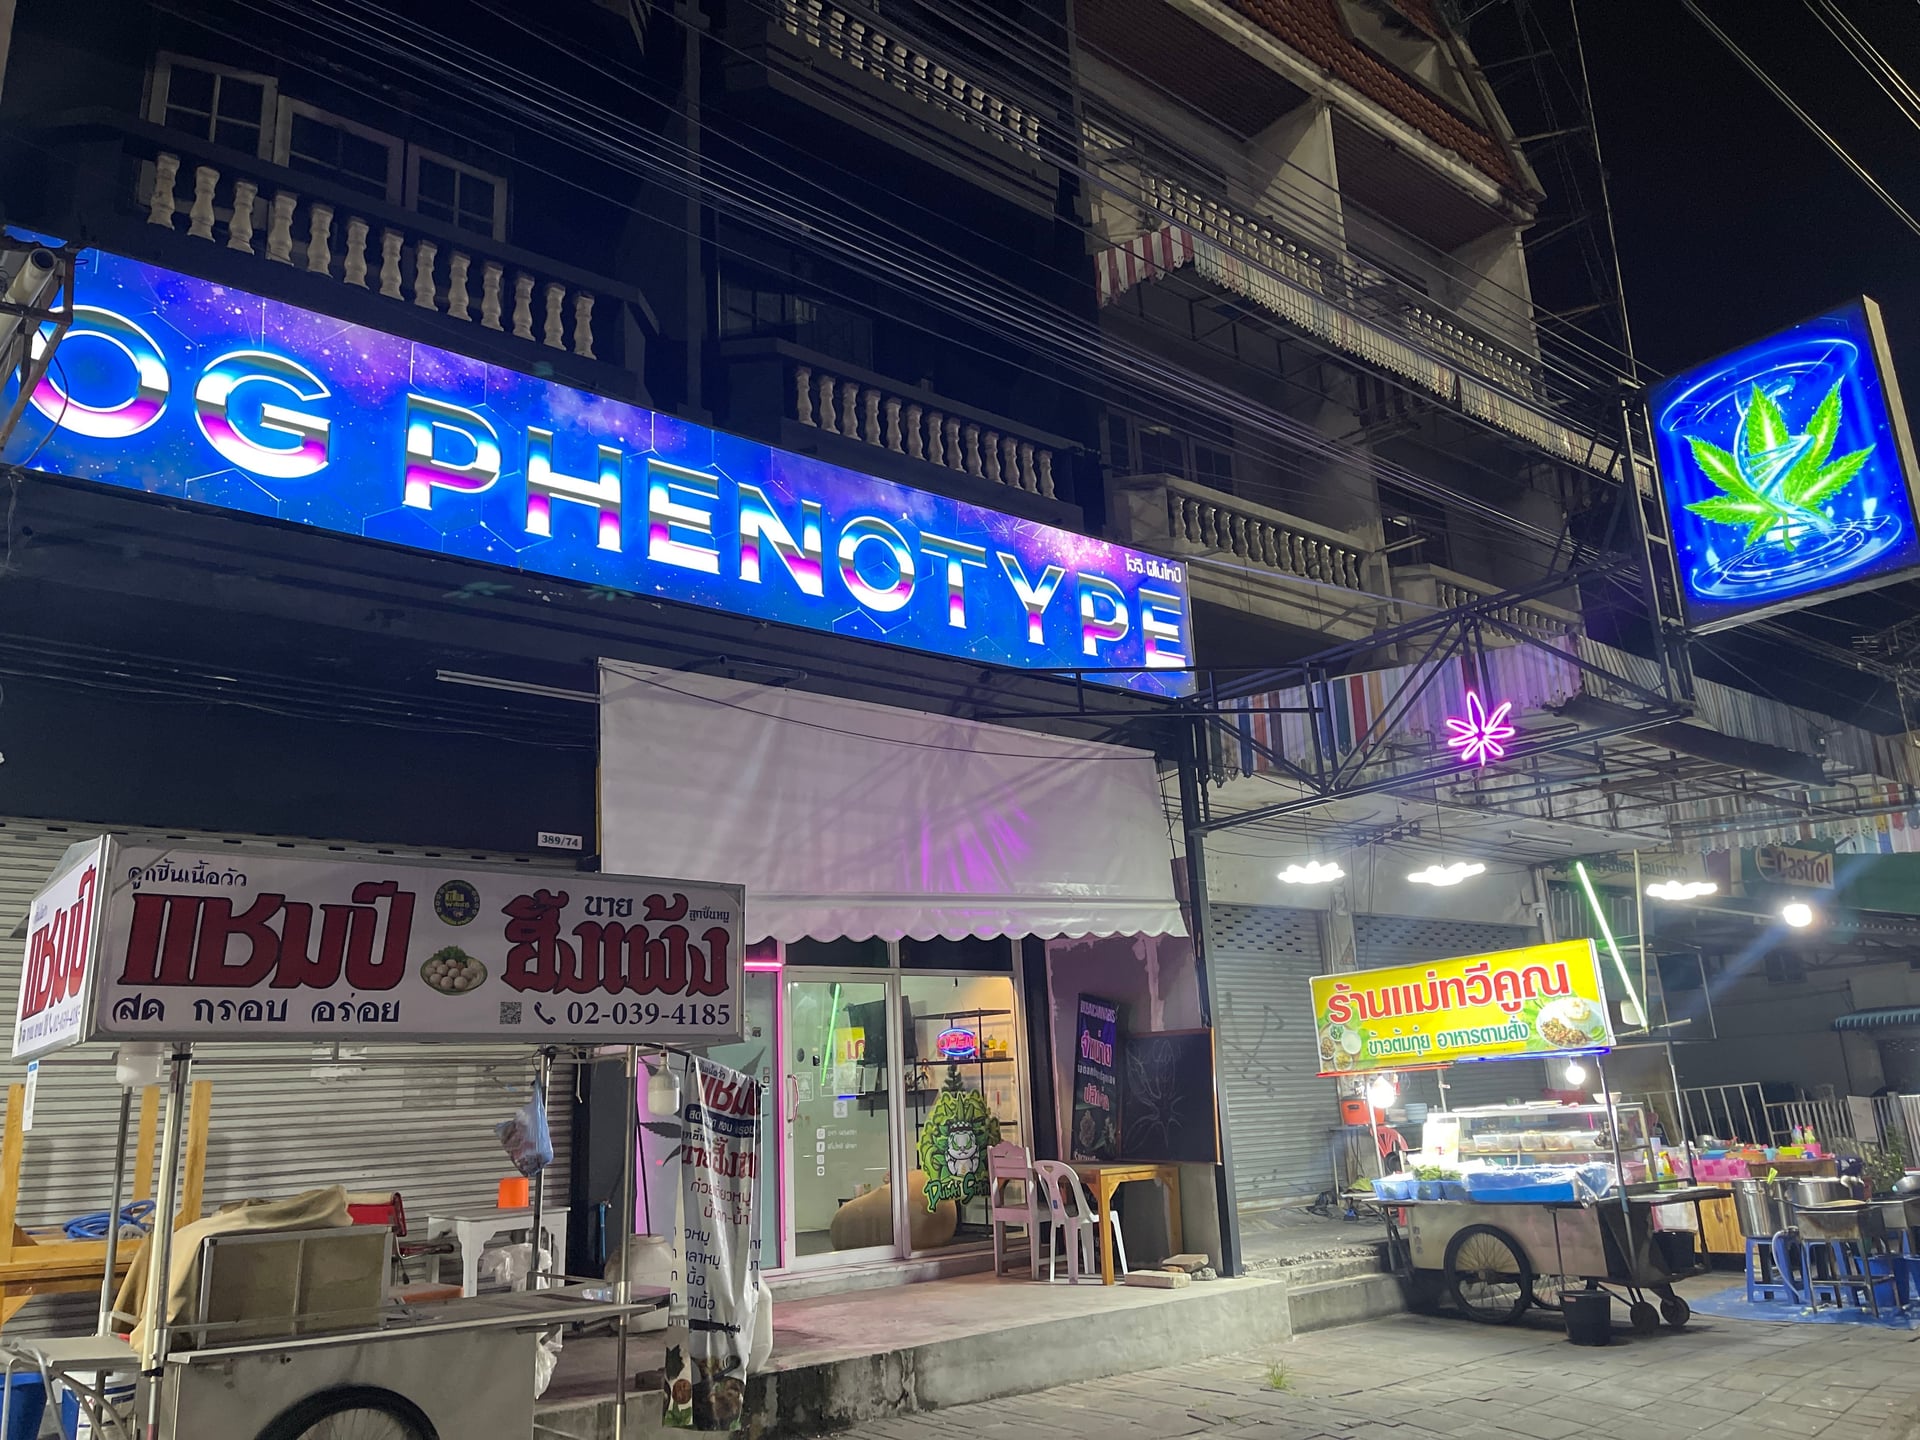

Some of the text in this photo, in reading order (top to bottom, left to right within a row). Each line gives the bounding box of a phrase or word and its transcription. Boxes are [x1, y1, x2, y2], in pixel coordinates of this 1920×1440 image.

[16, 304, 1187, 672] OG PHENOTYPE
[541, 834, 579, 847] 389/74
[1777, 851, 1832, 885] Castrol
[584, 895, 634, 918] นาย
[112, 992, 401, 1025] สด กรอบ อร่อย
[1328, 962, 1570, 1024] ร้านแม่ทวีคูณ
[567, 1001, 731, 1026] 02-039-4185
[937, 1033, 975, 1050] OPEN
[1437, 1015, 1529, 1047] อาหารตามสั่ง
